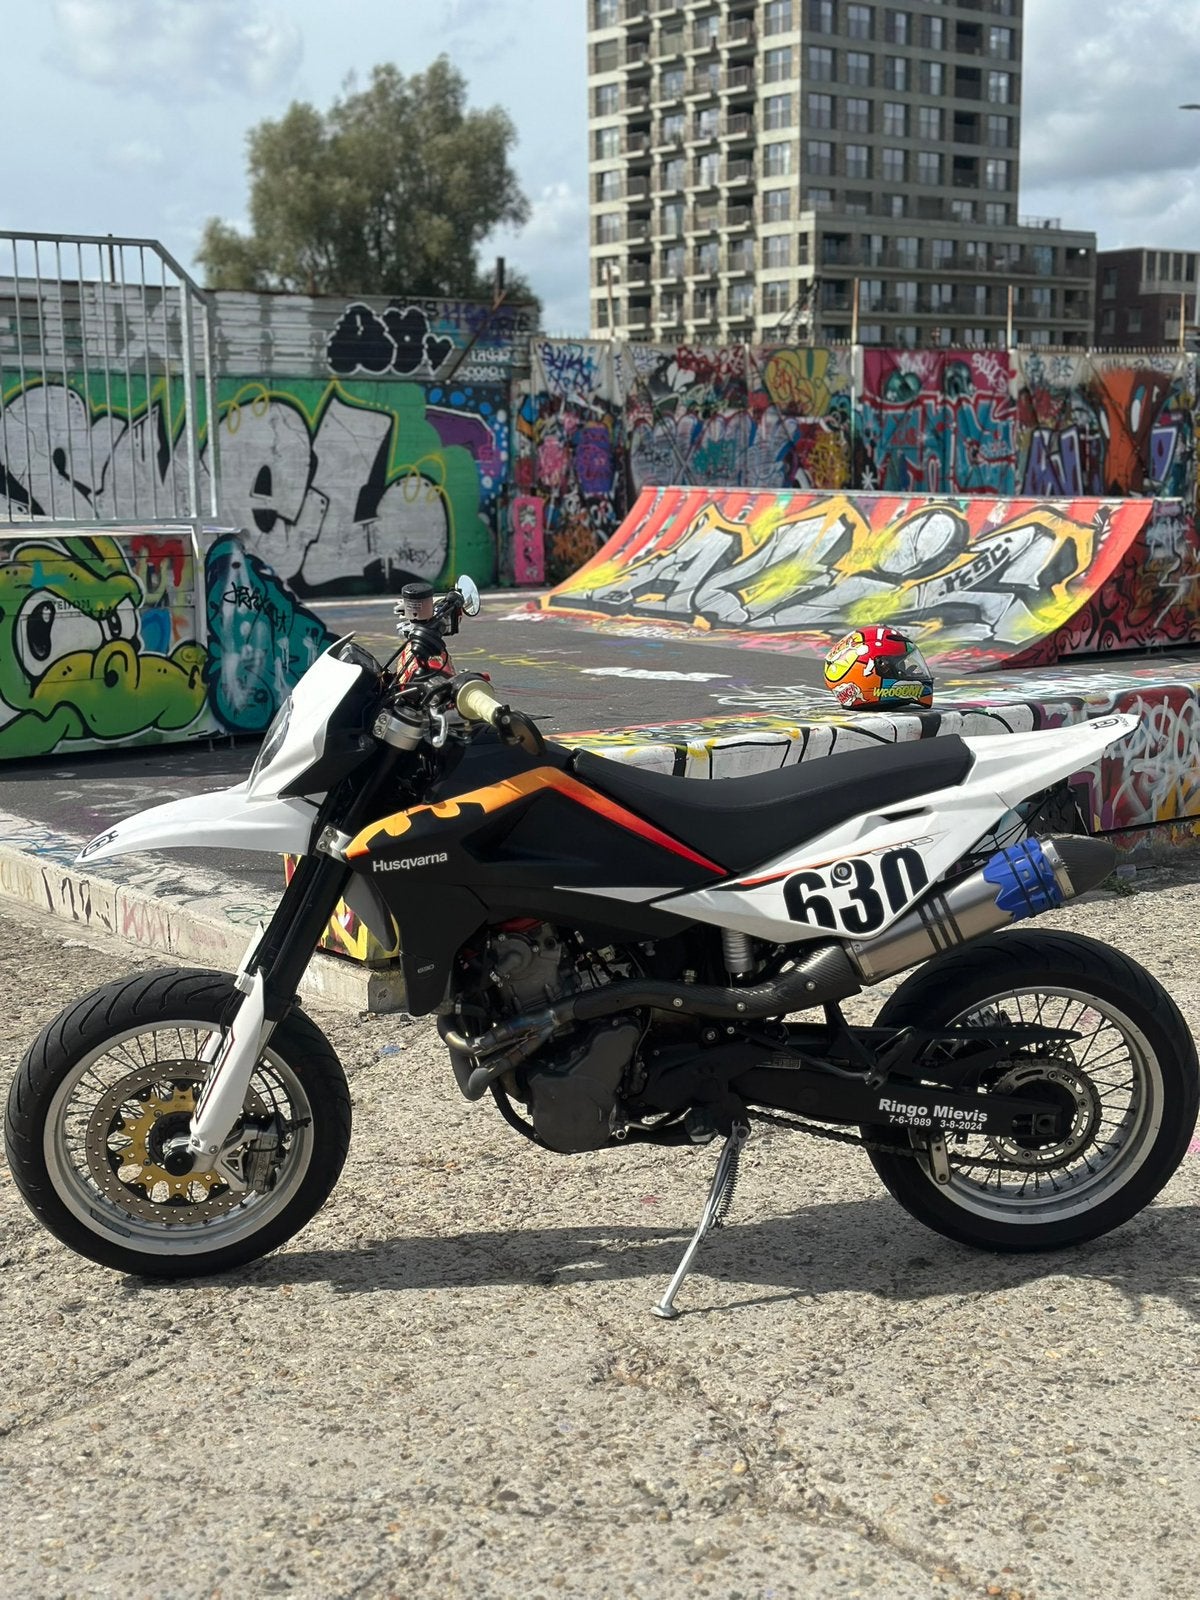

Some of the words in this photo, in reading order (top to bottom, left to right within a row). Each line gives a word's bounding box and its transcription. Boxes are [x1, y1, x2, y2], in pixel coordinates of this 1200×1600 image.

[372, 852, 448, 872] Husqvarna
[783, 848, 929, 934] 630
[879, 1098, 928, 1117] Ringo
[933, 1105, 988, 1122] Mievis
[889, 1115, 932, 1127] 7-6-1989
[940, 1119, 983, 1131] 3-8-2024
